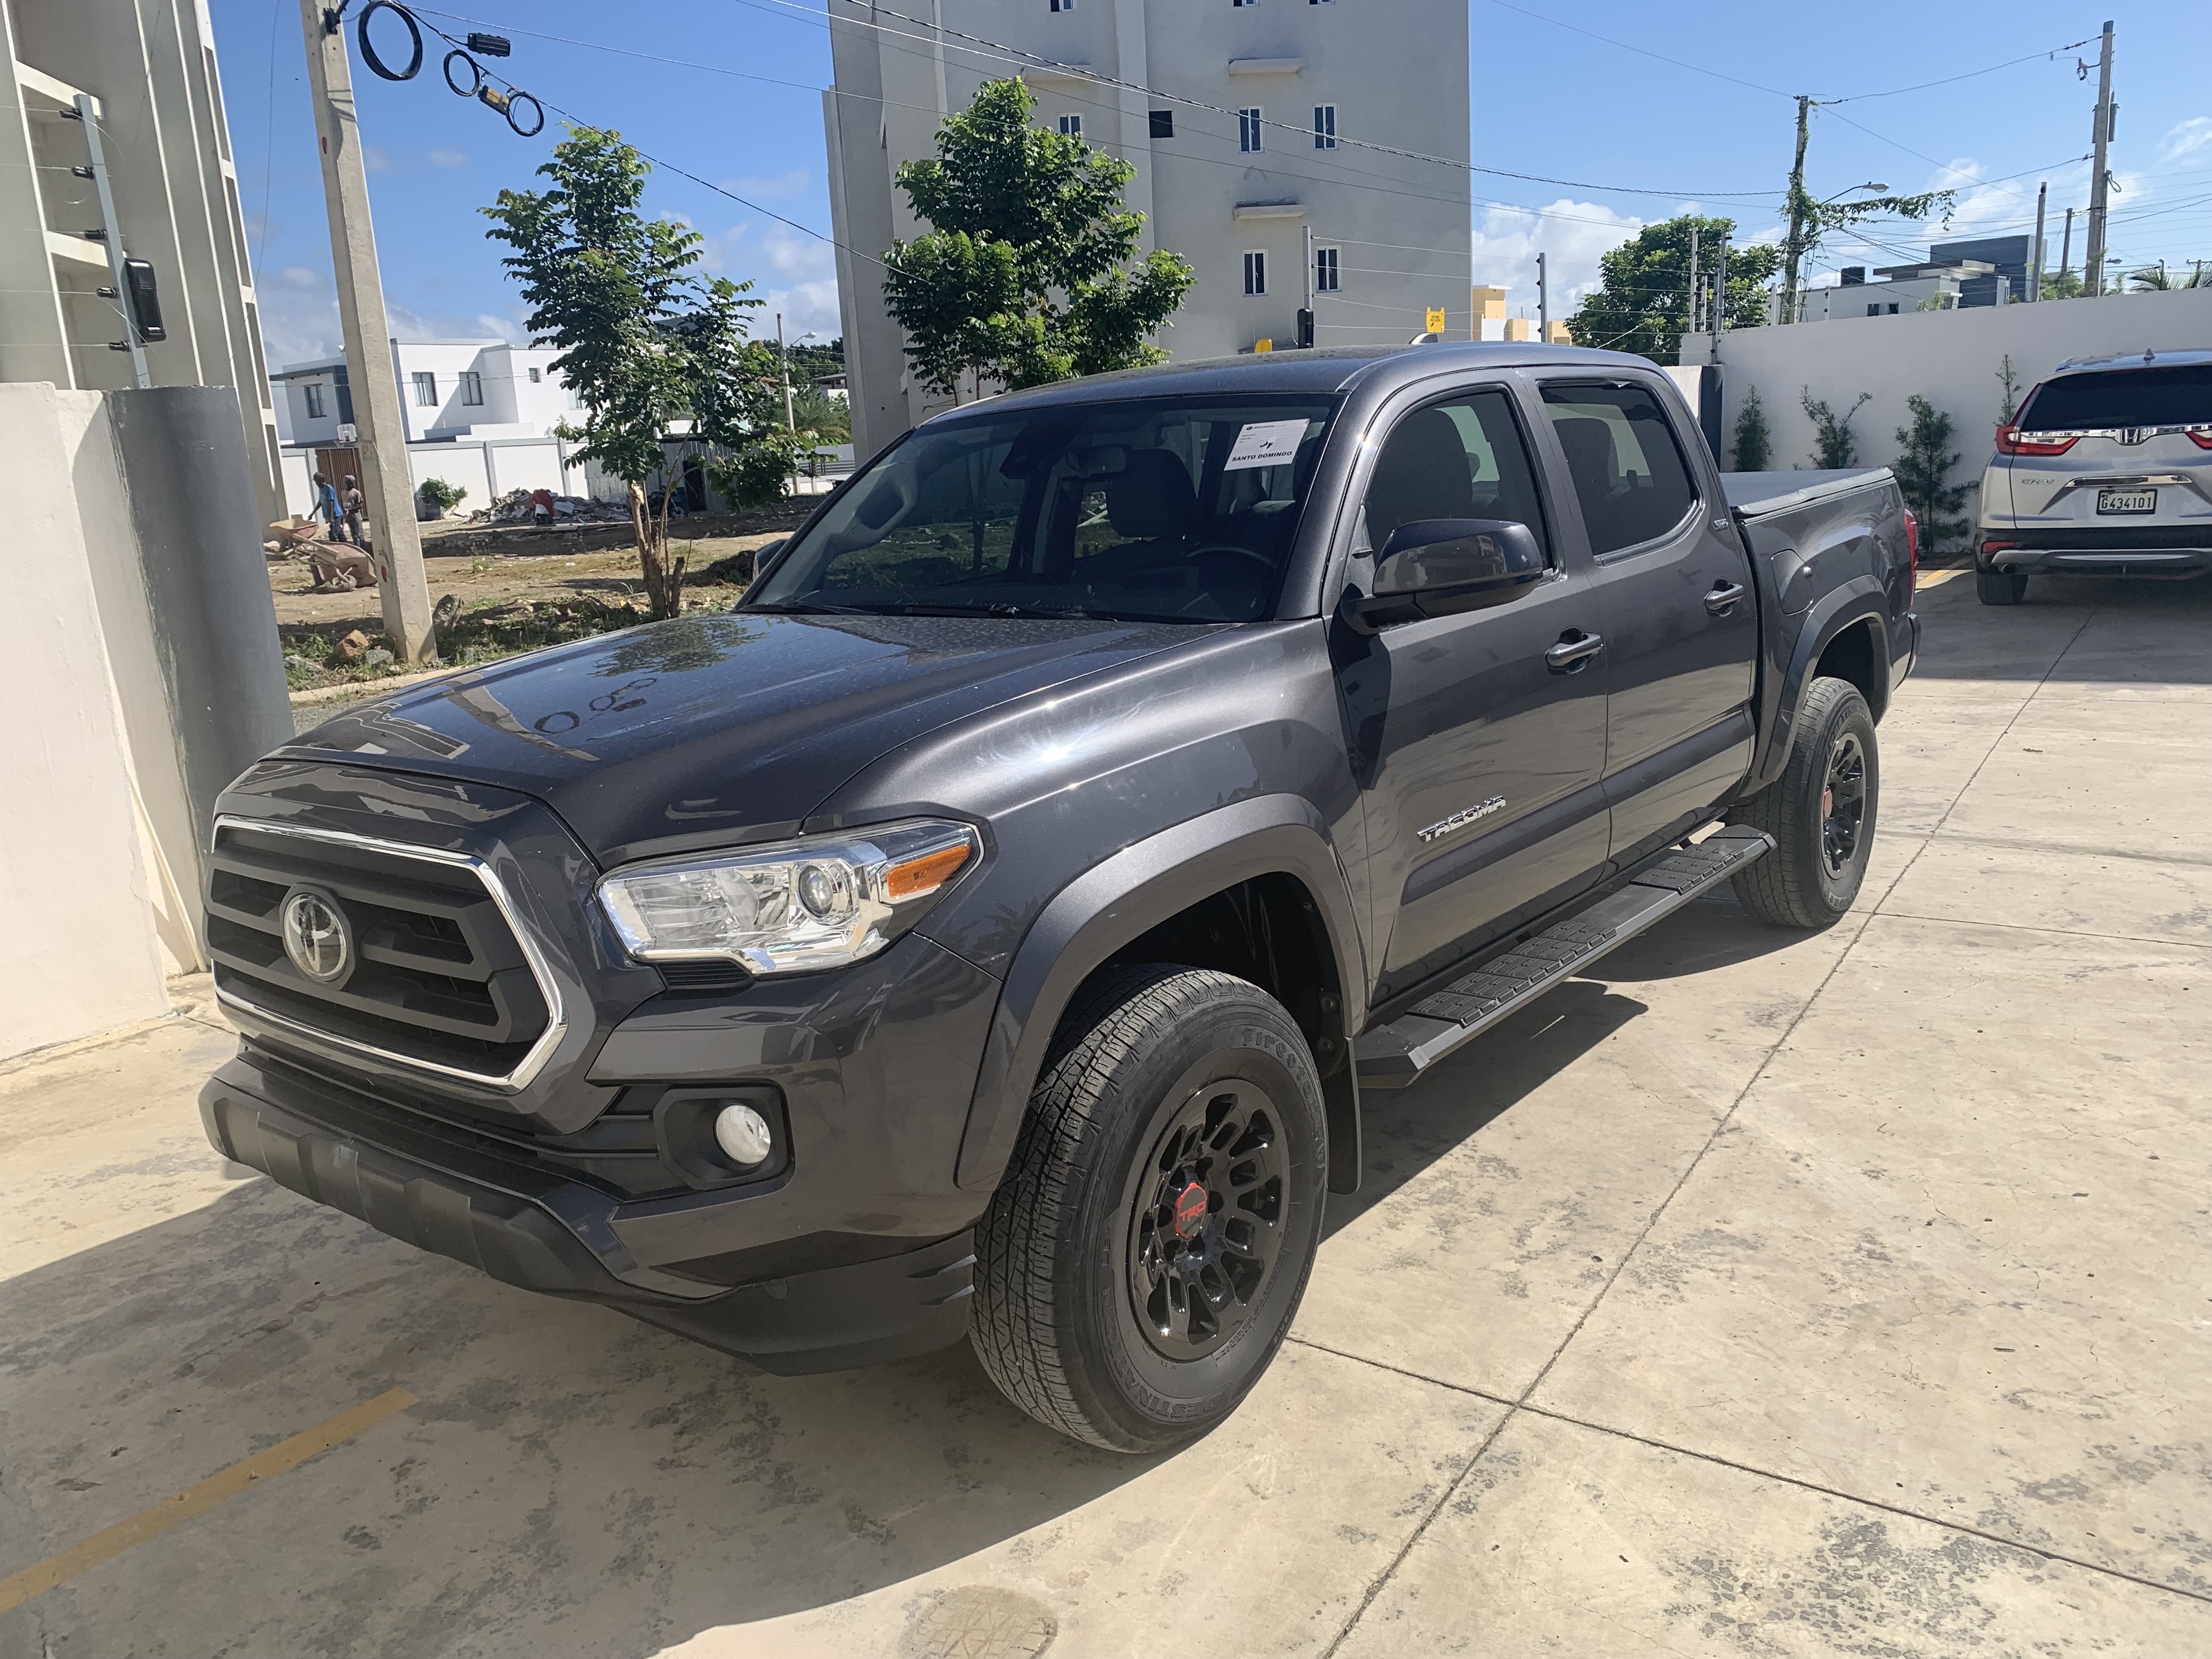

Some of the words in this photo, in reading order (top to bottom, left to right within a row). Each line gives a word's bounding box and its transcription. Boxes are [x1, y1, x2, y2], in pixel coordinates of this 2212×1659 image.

[2101, 497, 2152, 509] G434101
[1417, 794, 1506, 843] TACOMA
[1178, 1200, 1206, 1222] TRD
[1101, 1289, 1223, 1418] DESTINATION
